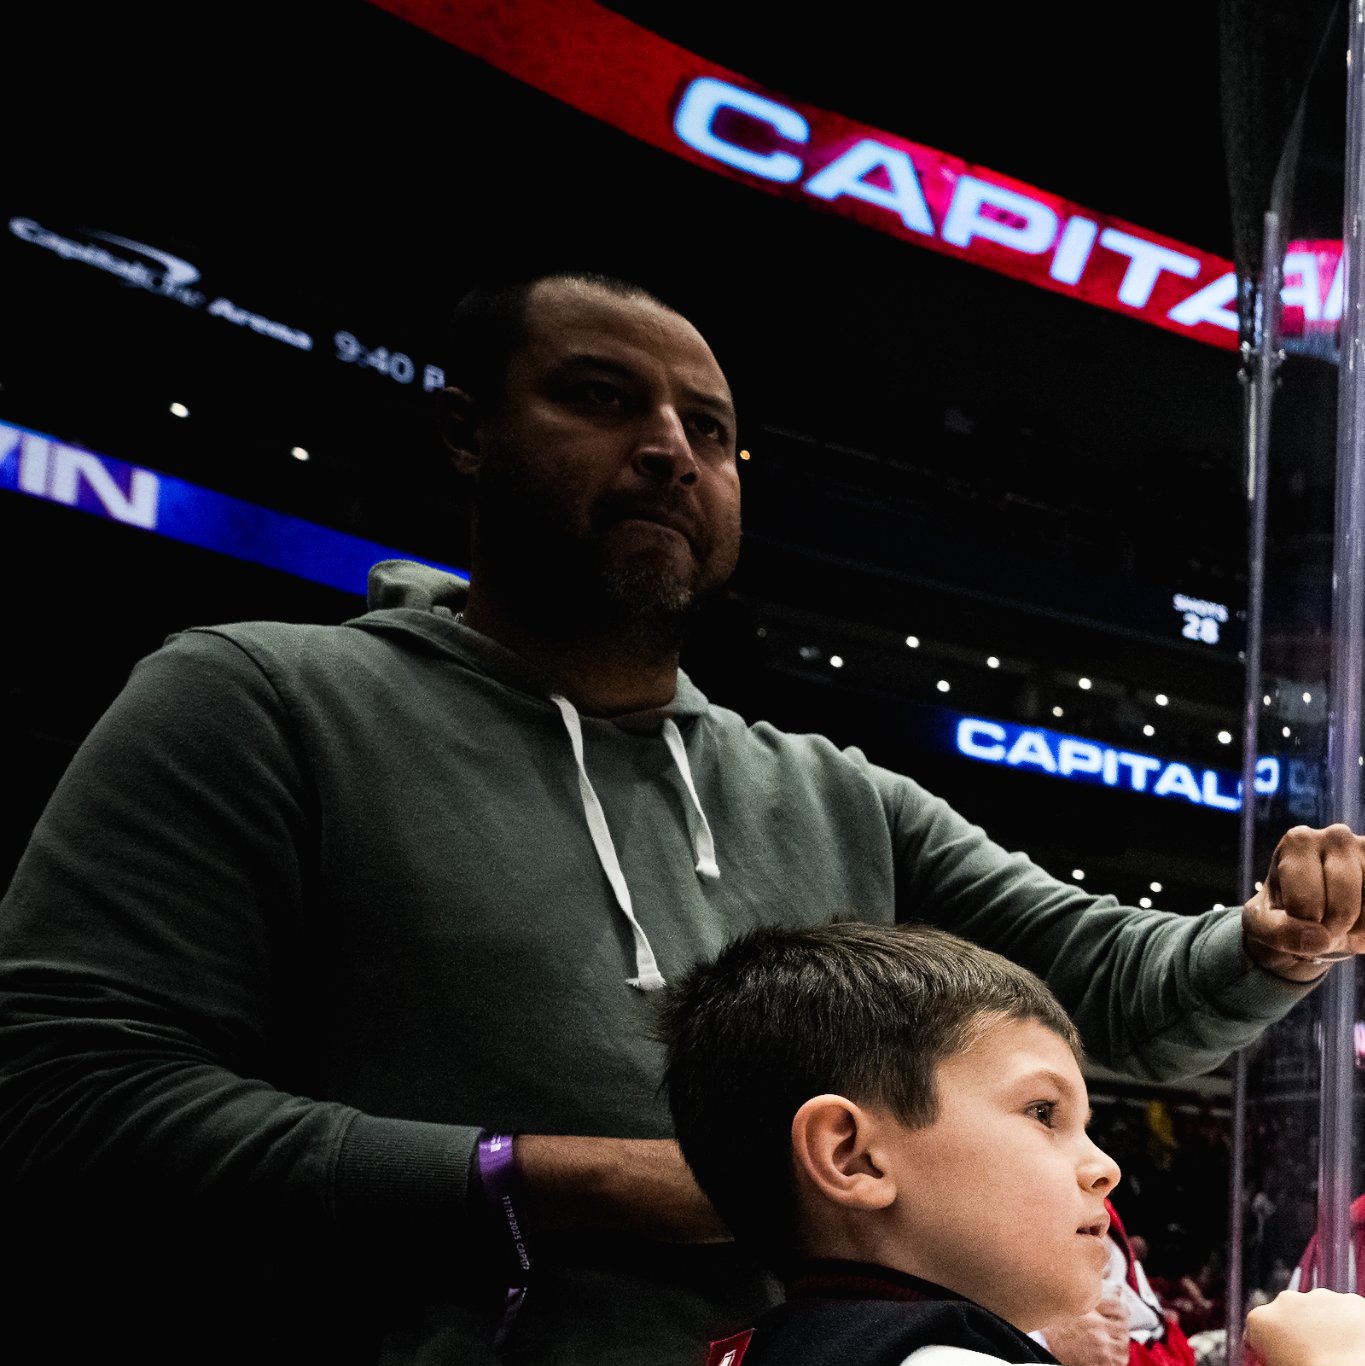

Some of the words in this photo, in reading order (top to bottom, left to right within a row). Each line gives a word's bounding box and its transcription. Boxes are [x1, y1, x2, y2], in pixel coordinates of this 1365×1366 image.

[335, 331, 415, 384] 9:40
[0, 420, 160, 530] IN
[955, 716, 1246, 811] CAPITAL
